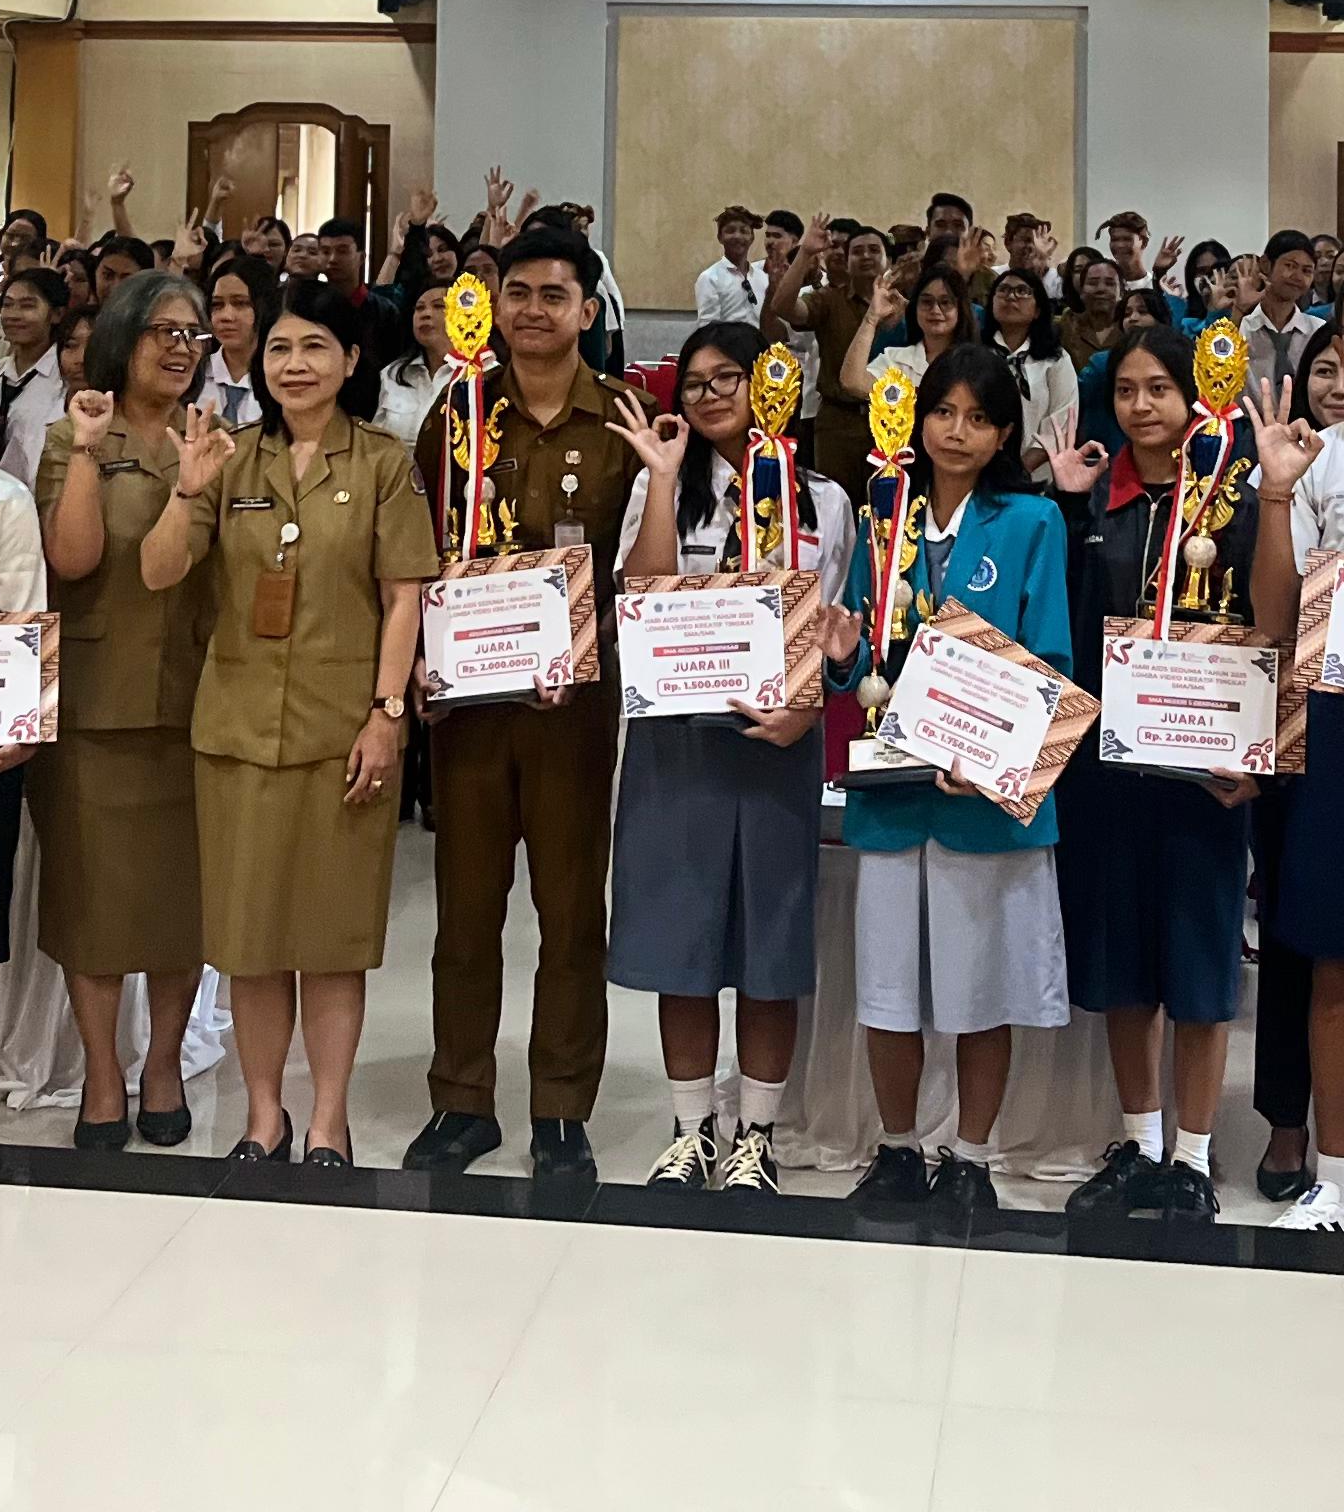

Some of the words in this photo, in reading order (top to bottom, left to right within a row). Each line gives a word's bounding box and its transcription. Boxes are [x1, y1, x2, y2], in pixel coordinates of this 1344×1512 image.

[474, 640, 513, 655] JUARA
[462, 664, 478, 674] Rp.
[673, 660, 716, 673] JUARA
[719, 659, 730, 670] III
[663, 682, 681, 692] Rp.
[684, 678, 743, 690] 1.500.0000
[939, 710, 979, 736] JUARA
[979, 728, 989, 741] II
[1161, 712, 1206, 726] JUARA
[921, 724, 939, 740] Rp.
[1144, 731, 1162, 742] Rp.
[1166, 733, 1228, 747] 2.000.0000
